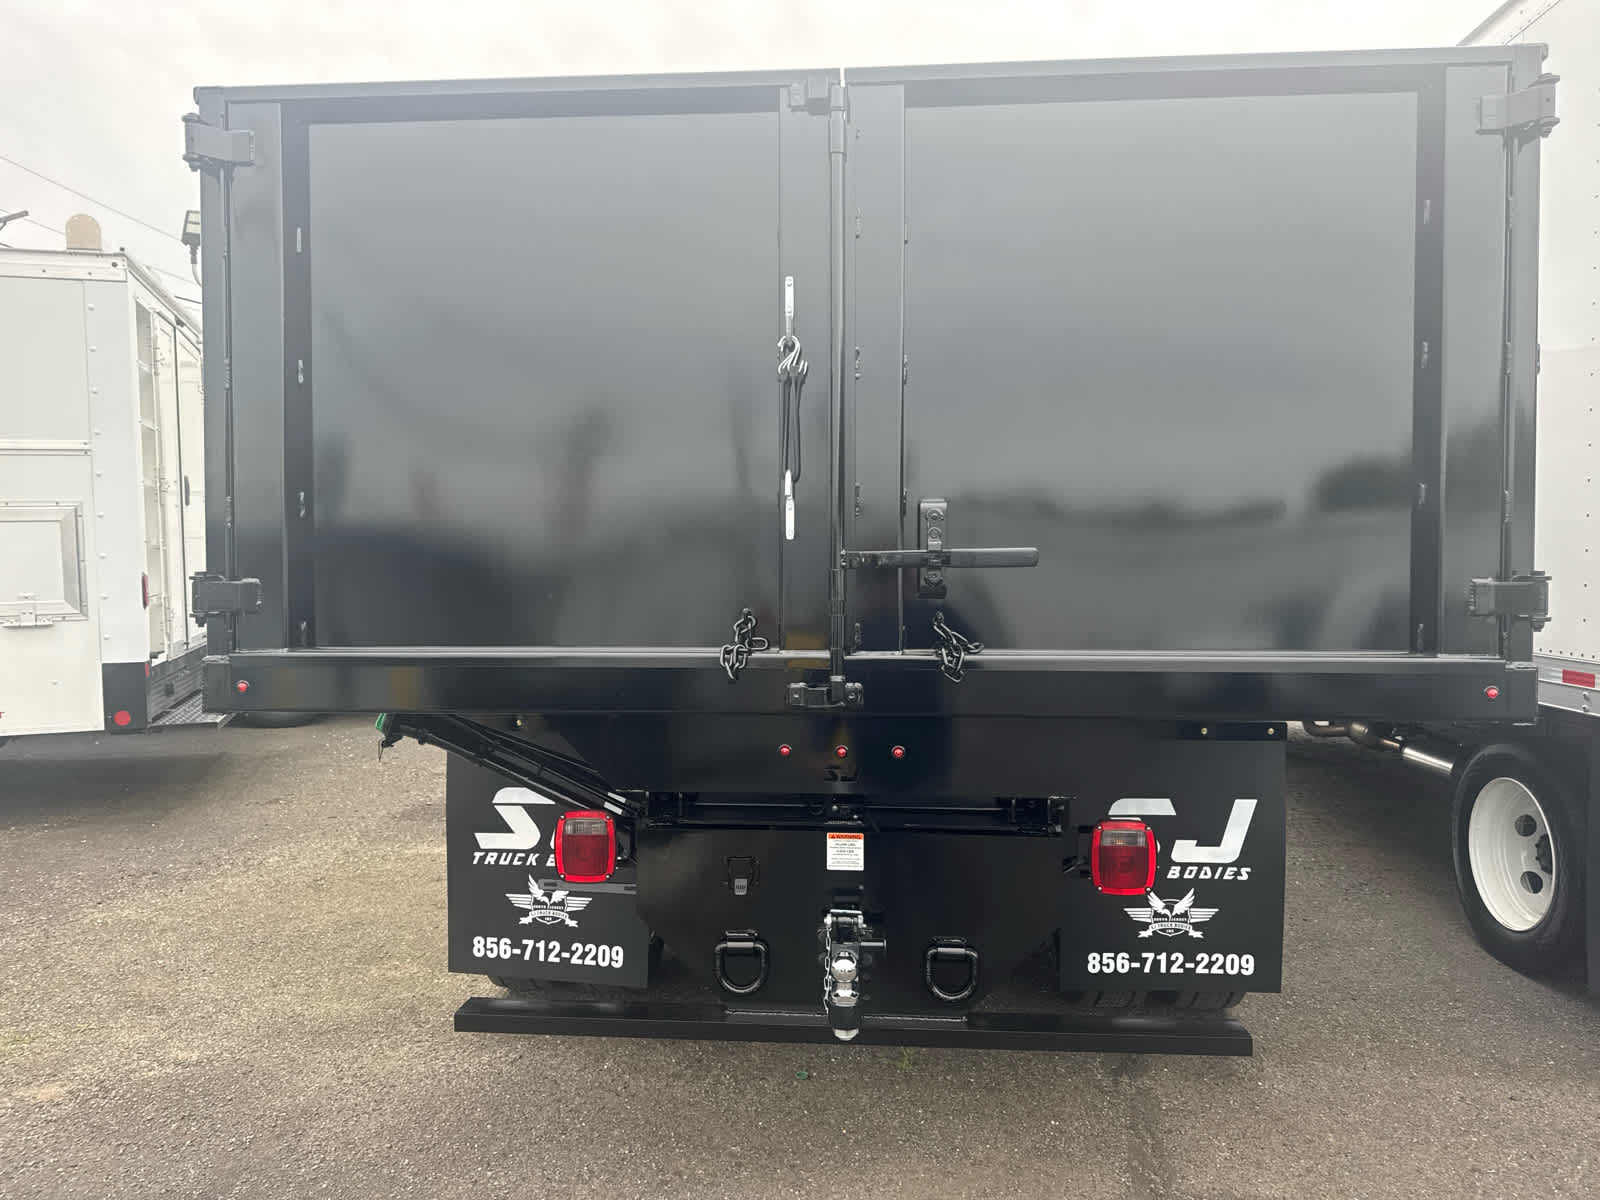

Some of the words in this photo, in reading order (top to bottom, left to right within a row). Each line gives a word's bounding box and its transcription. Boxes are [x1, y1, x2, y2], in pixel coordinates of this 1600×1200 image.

[472, 851, 541, 867] TRUCK
[1166, 865, 1252, 881] BODIES
[472, 936, 624, 968] 856-712-2209
[1087, 952, 1255, 976] 856-712-2209
